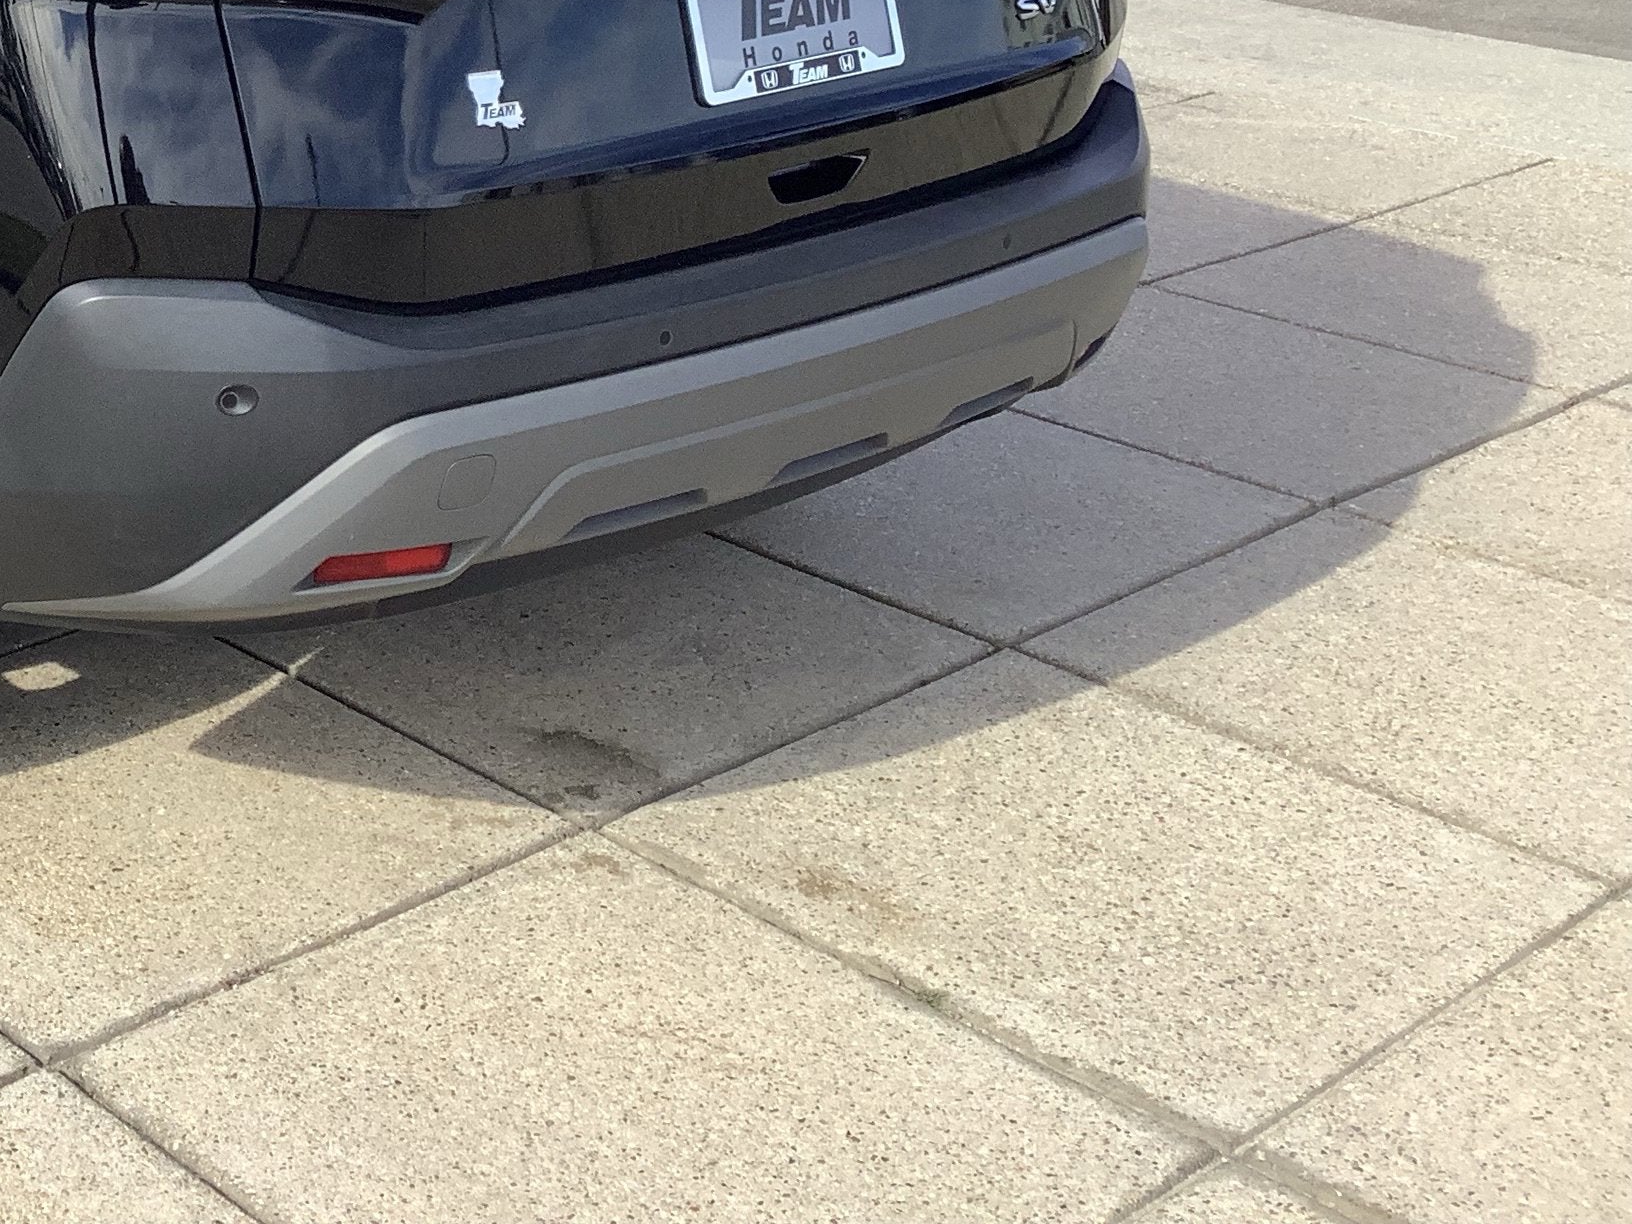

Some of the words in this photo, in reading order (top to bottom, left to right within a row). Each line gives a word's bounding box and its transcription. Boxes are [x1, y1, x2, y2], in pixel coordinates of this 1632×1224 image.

[743, 30, 860, 68] Honda
[789, 63, 829, 86] TEAM
[480, 102, 516, 120] TEAM
